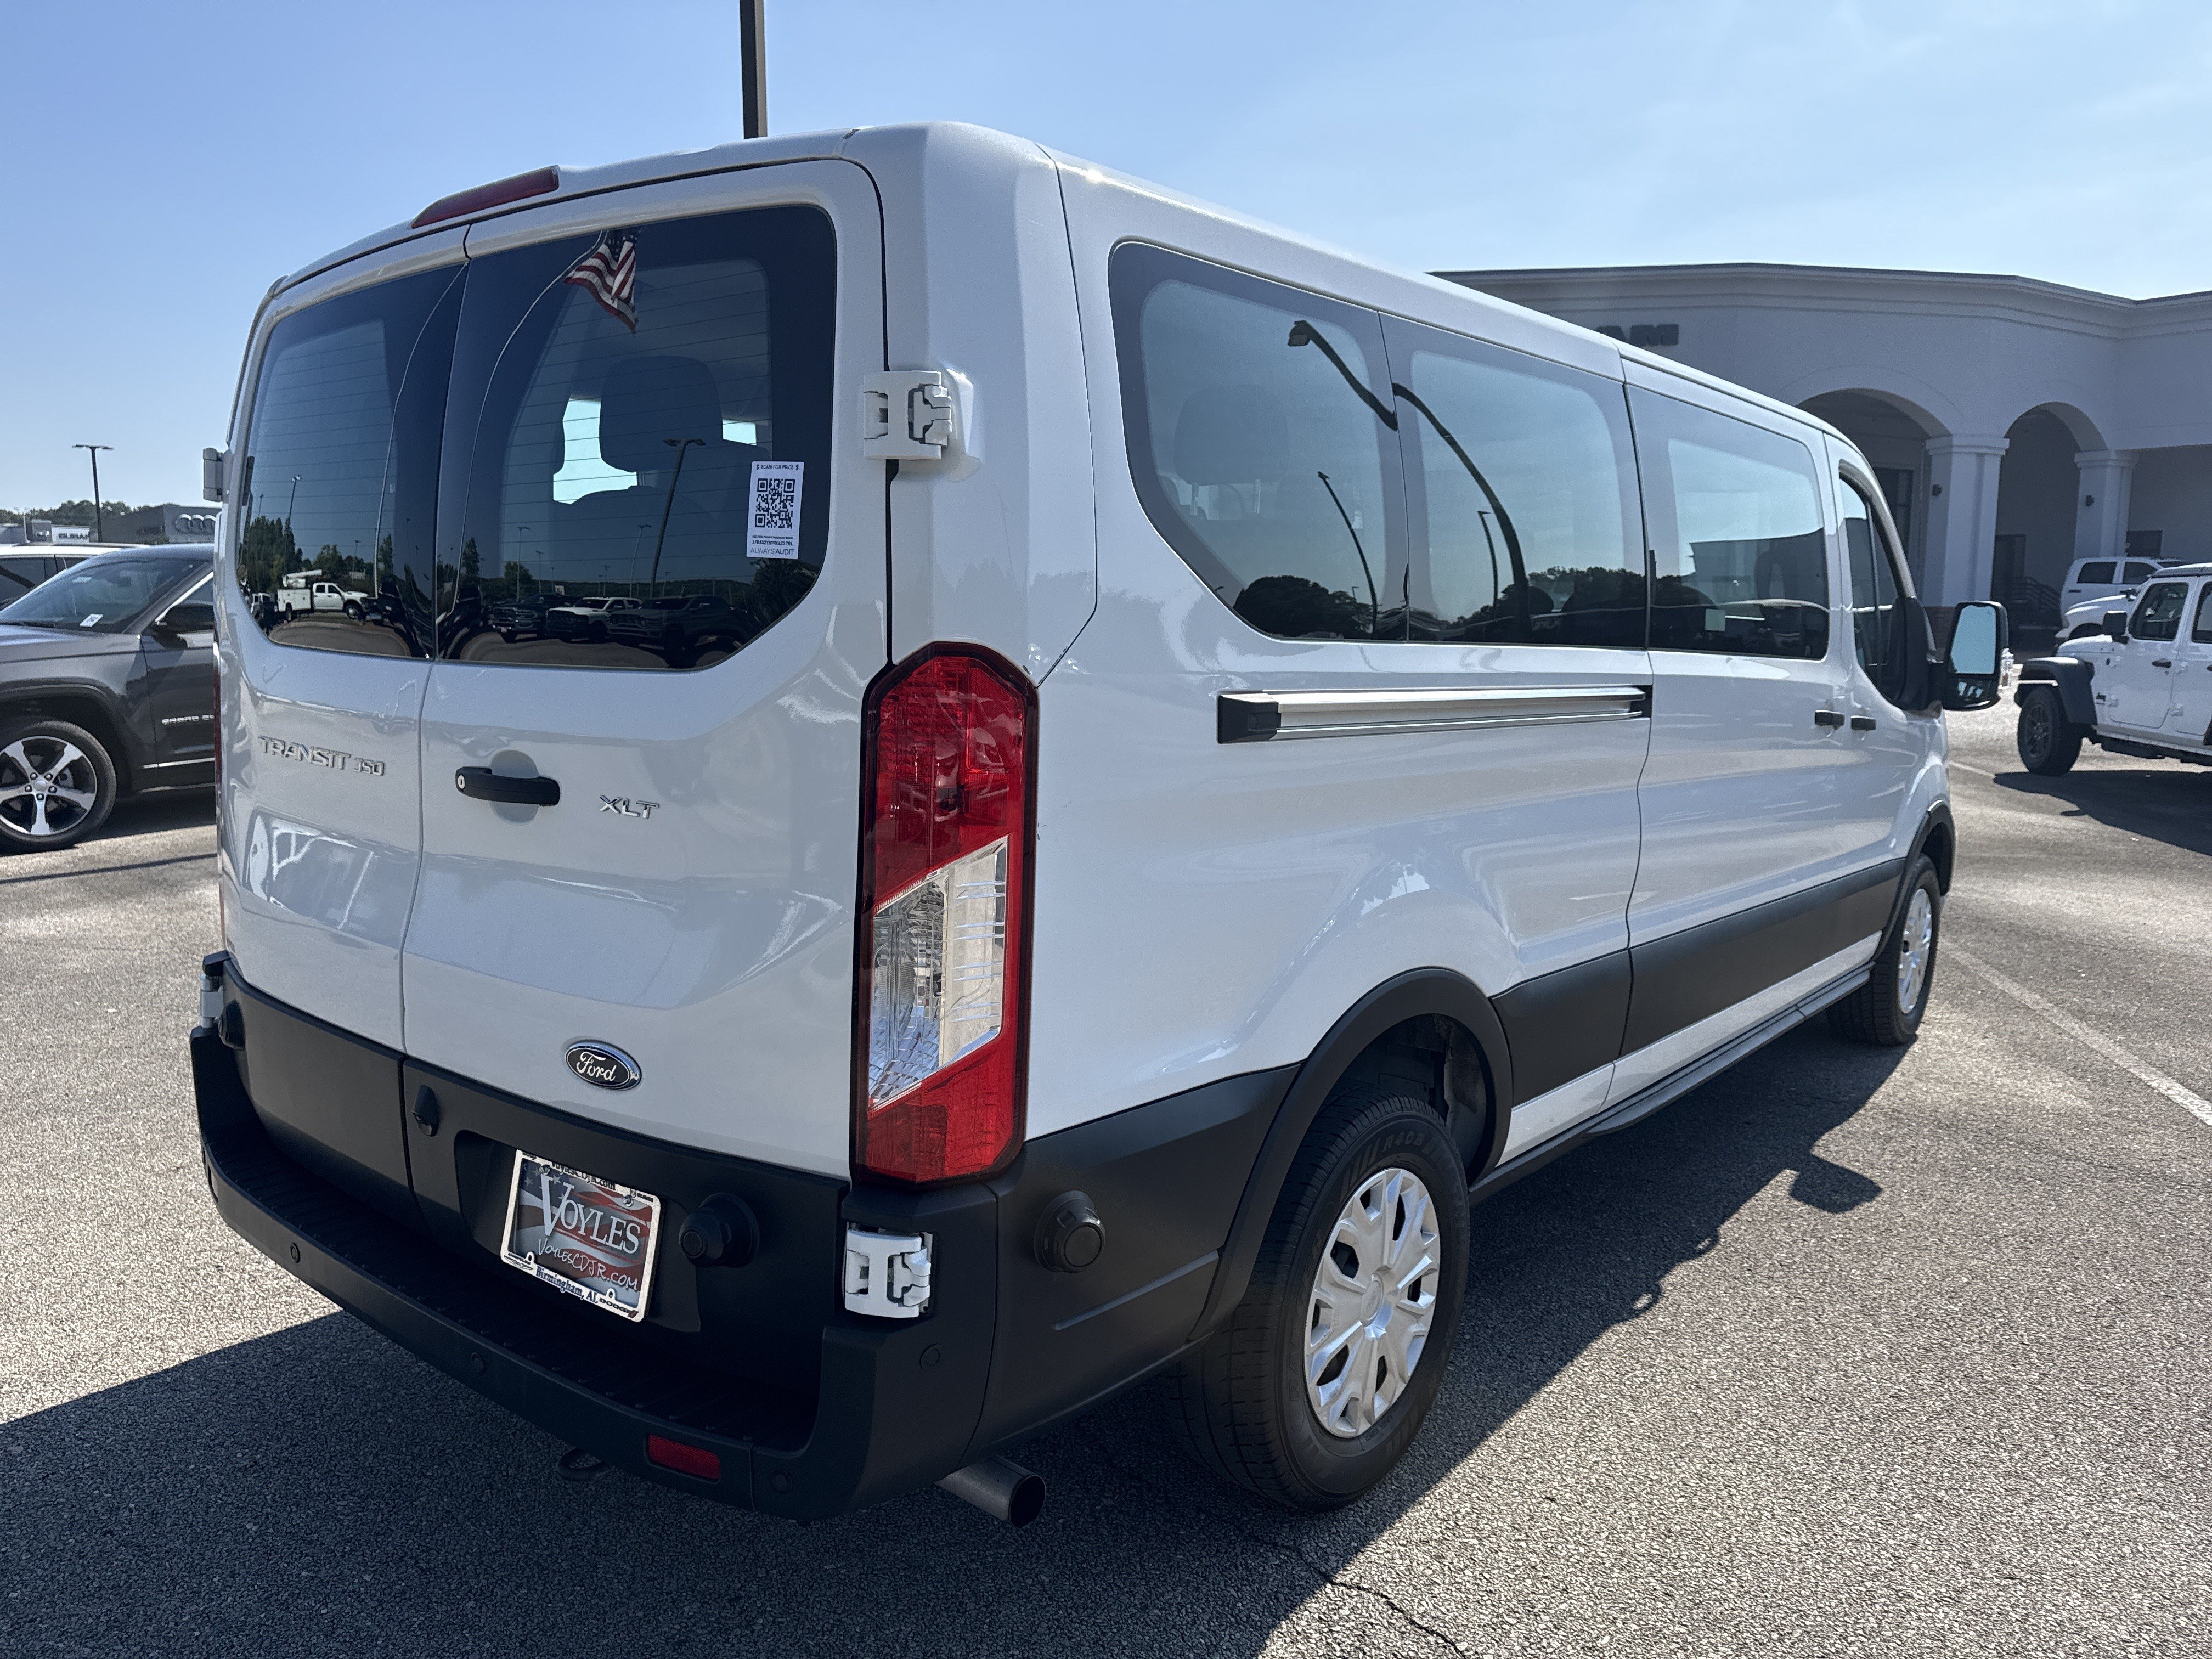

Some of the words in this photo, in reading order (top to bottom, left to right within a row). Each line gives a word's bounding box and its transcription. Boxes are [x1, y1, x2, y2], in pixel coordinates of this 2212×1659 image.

[258, 735, 352, 770] TRANSIT
[352, 757, 385, 776] 350
[599, 794, 660, 819] XLT
[577, 1051, 617, 1081] Ford
[535, 1266, 584, 1300] Birmingham,
[585, 1290, 599, 1304] AL
